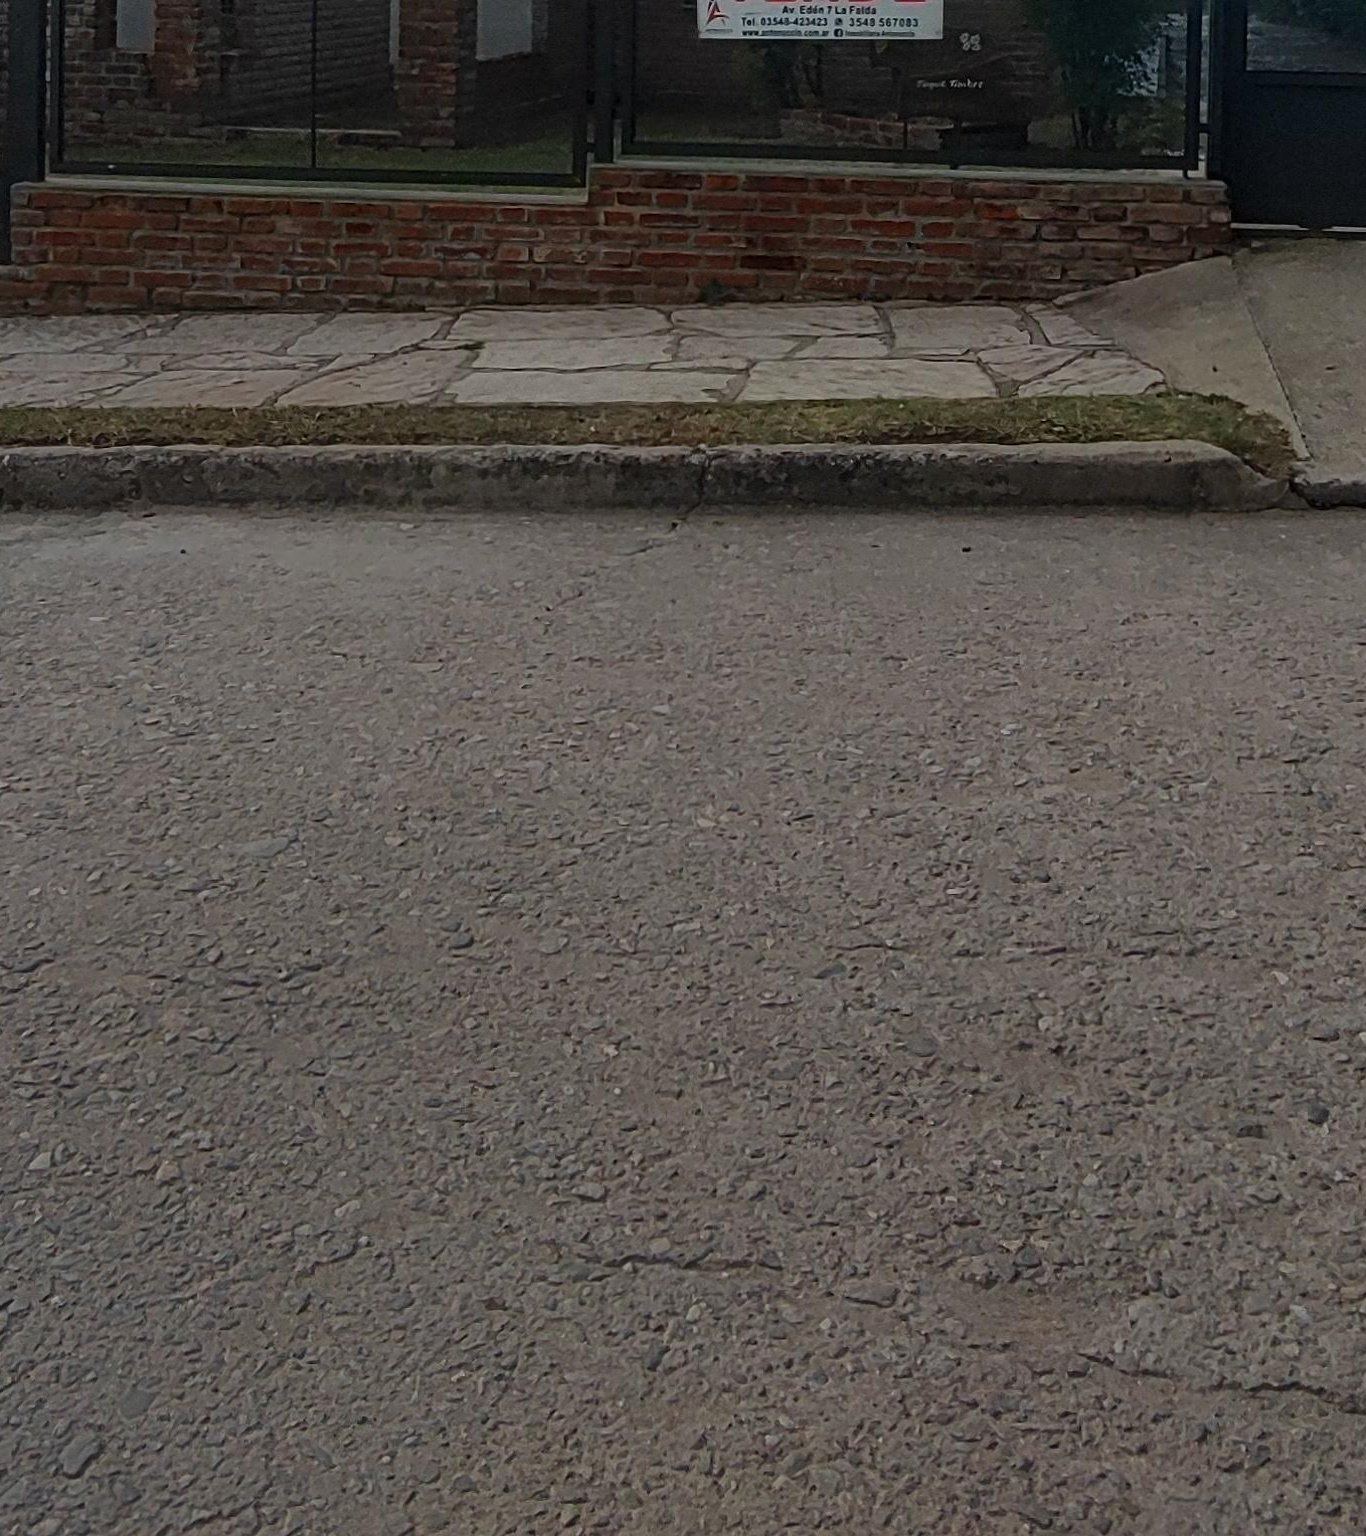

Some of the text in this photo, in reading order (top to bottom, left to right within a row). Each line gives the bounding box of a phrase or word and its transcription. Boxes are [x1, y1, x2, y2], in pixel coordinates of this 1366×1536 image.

[799, 4, 825, 15] Edén
[827, 5, 833, 15] 7
[835, 5, 847, 15] La
[849, 5, 877, 15] Falda
[760, 16, 829, 27] 03548-423423
[848, 17, 877, 28] 3548
[878, 17, 920, 28] 567083
